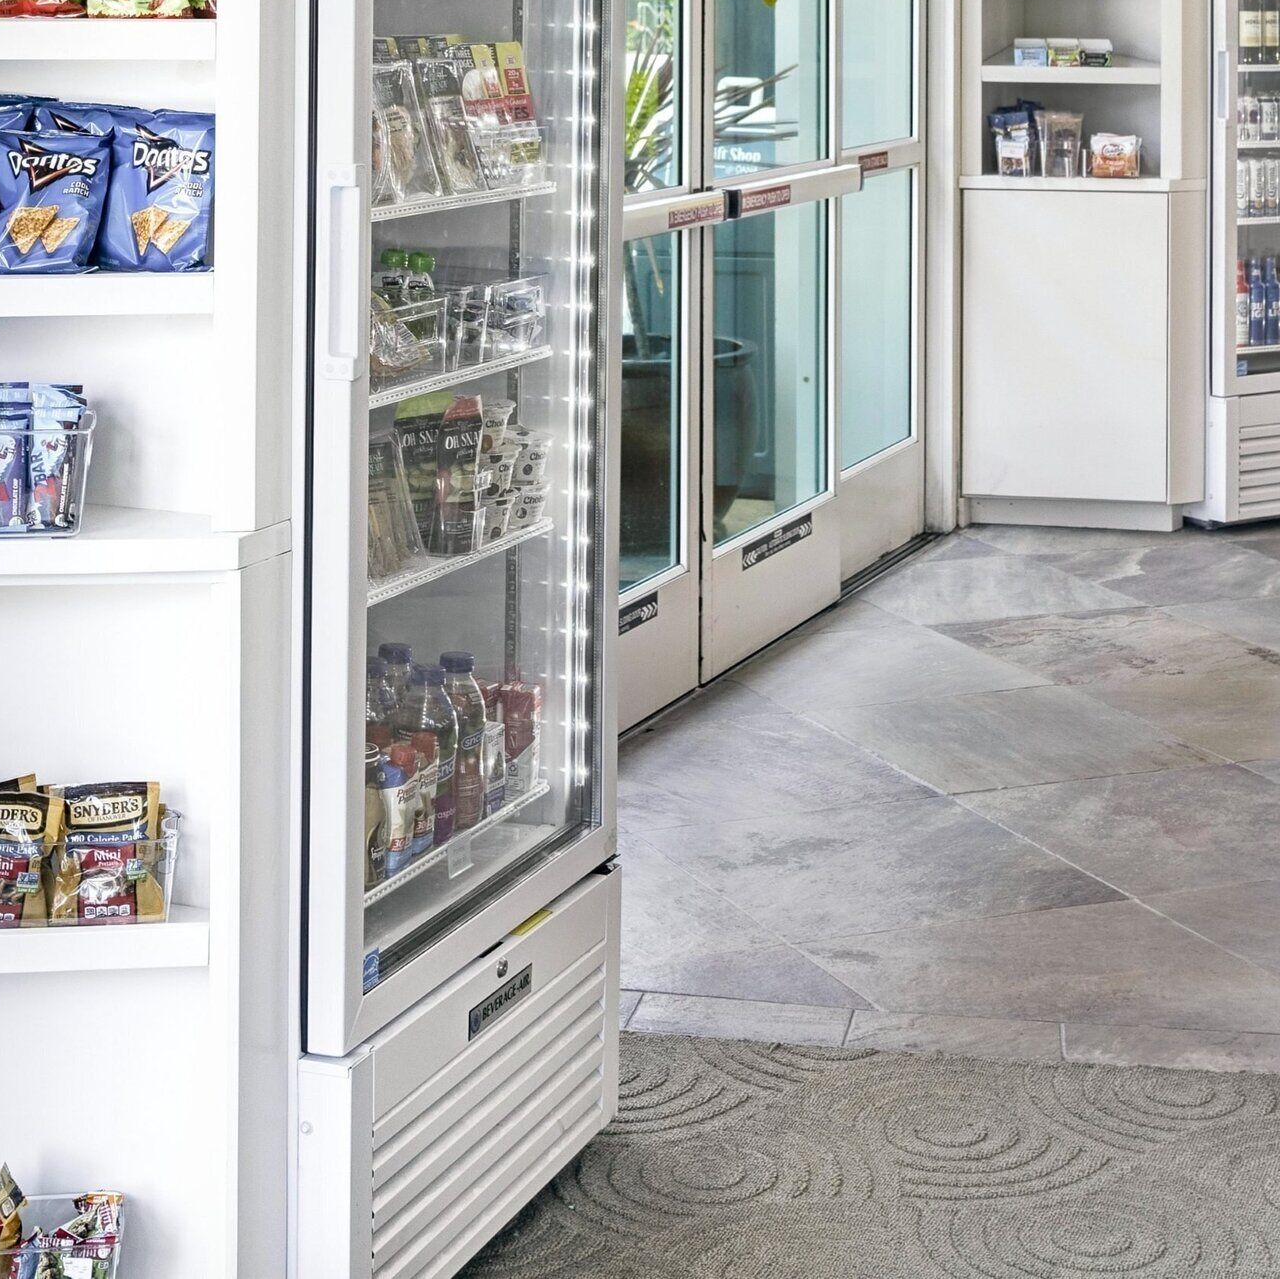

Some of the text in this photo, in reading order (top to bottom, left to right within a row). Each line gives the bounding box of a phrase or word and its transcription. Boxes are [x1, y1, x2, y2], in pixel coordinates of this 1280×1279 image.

[133, 140, 210, 171] Doritos
[730, 147, 762, 164] Shop
[8, 150, 98, 178] Doritos
[62, 187, 90, 198] RANCH
[70, 180, 89, 190] COOL
[445, 435, 460, 450] OH
[73, 797, 141, 819] SNYDER'S
[87, 834, 120, 843] Calorie
[122, 832, 143, 841] Pack
[93, 850, 121, 862] Mini
[482, 972, 530, 1022] BEVERAGE-AIR
